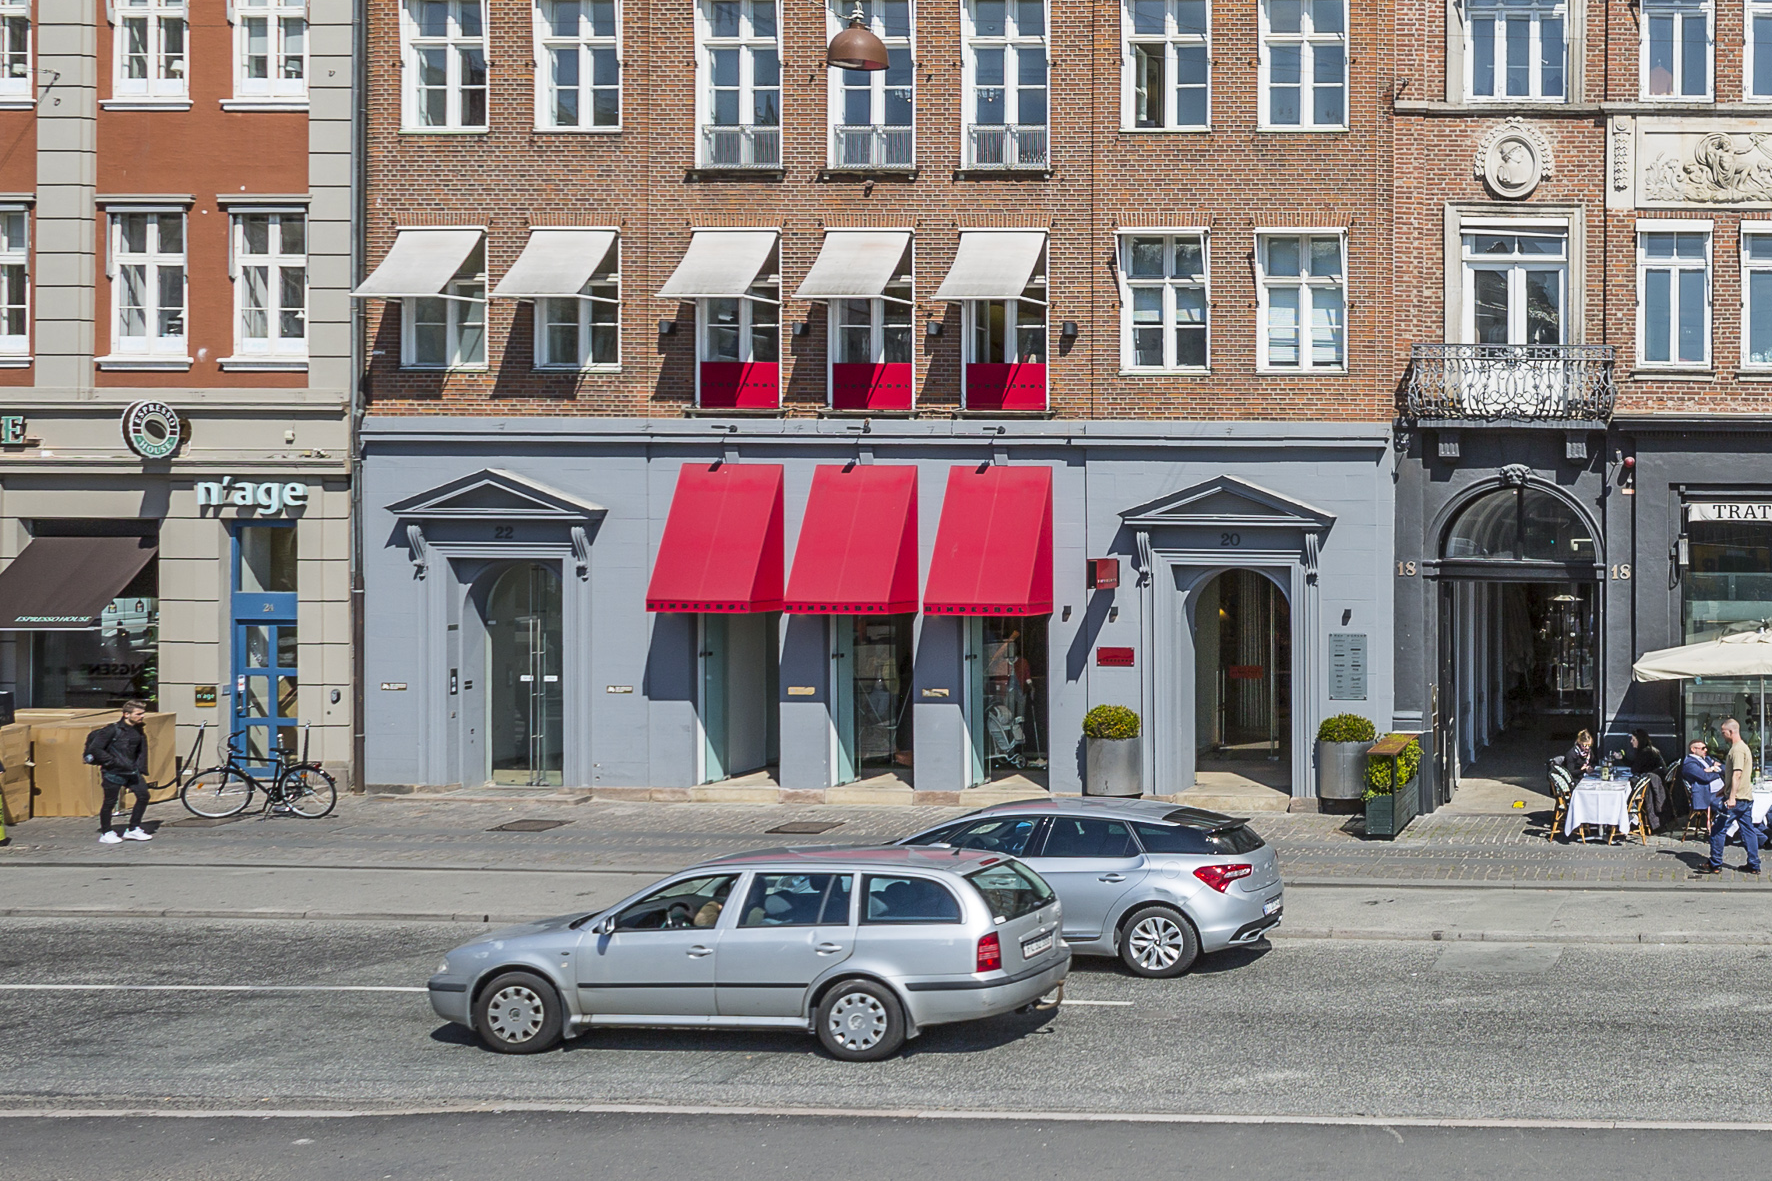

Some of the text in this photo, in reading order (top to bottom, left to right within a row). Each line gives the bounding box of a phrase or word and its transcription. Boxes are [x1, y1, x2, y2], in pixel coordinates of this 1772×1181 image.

[134, 402, 176, 426] ESPRESSO
[139, 440, 173, 455] HOUSE
[197, 476, 308, 514] n'age
[494, 526, 514, 539] 22
[1220, 533, 1241, 547] 20
[1397, 561, 1417, 576] 18
[1611, 563, 1631, 580] 18
